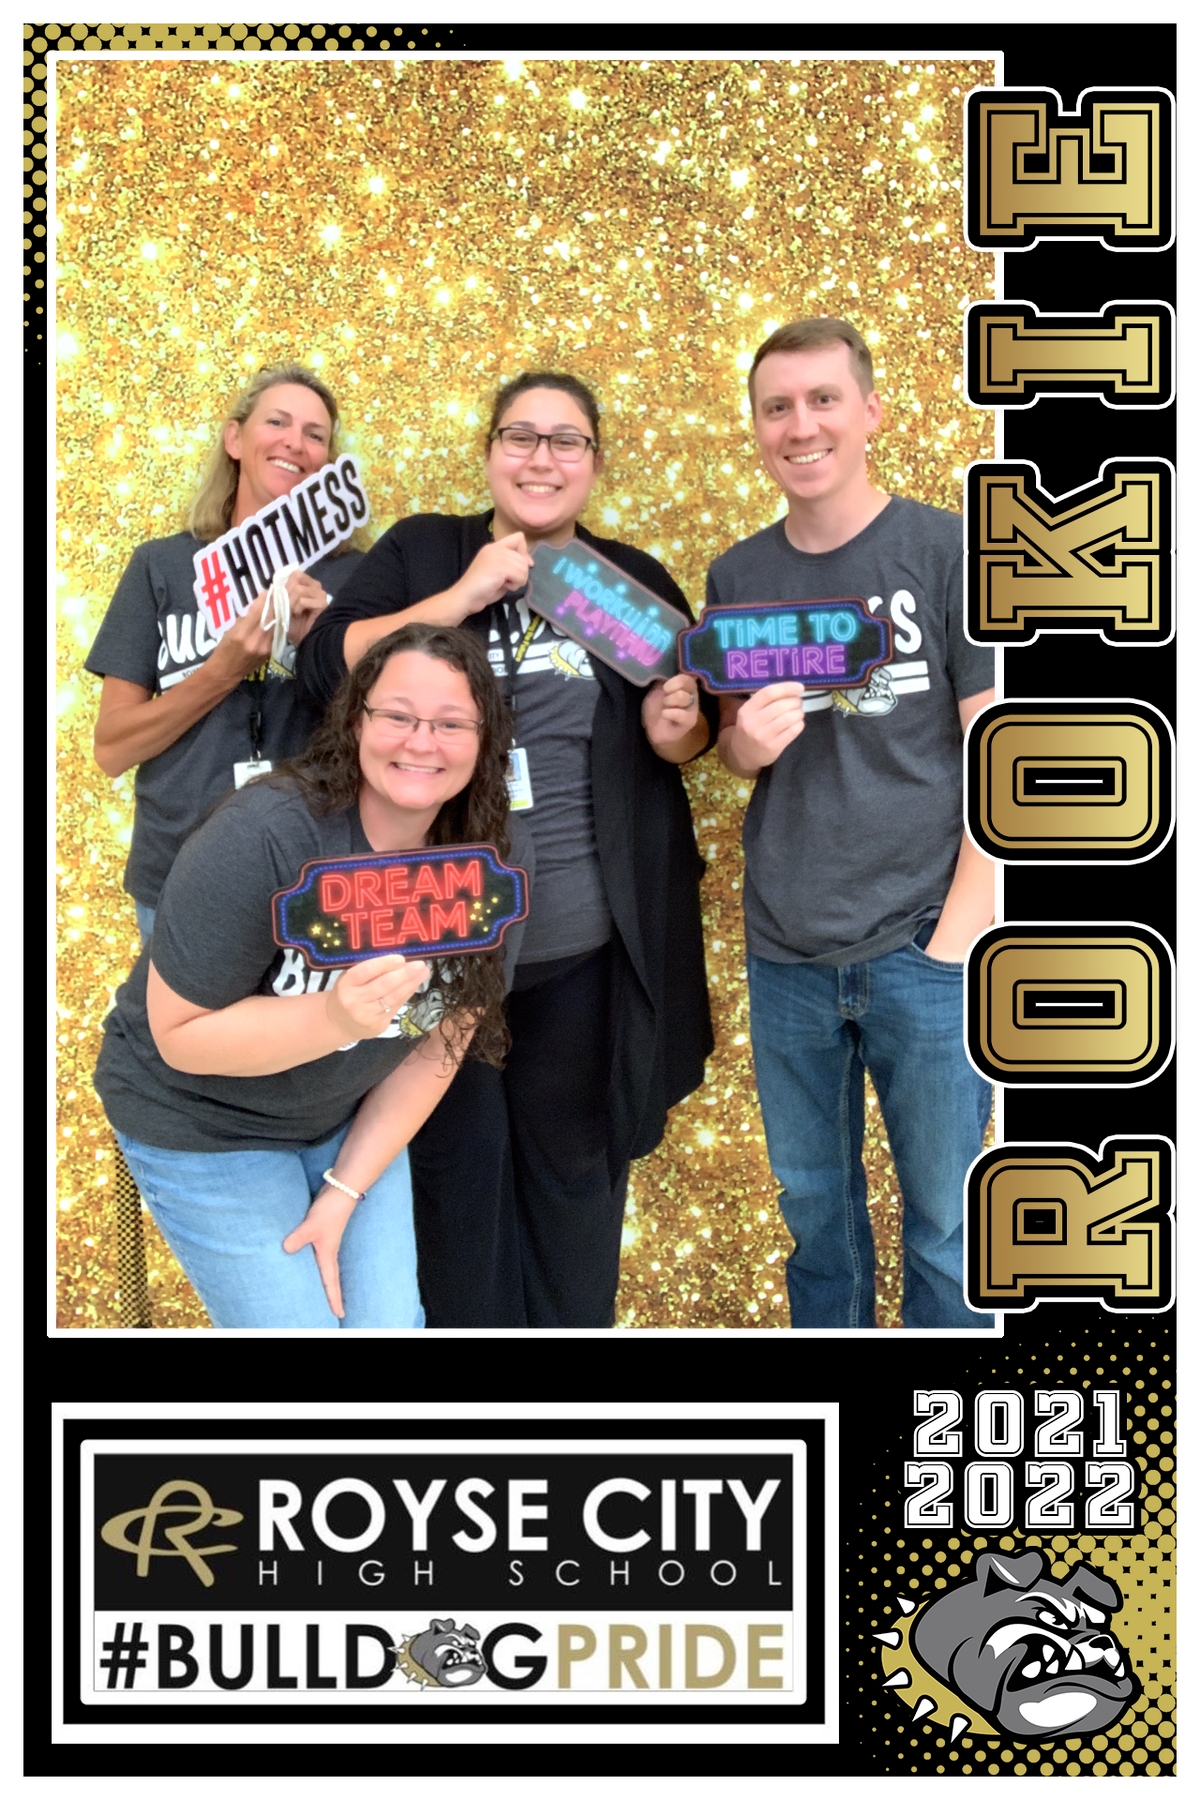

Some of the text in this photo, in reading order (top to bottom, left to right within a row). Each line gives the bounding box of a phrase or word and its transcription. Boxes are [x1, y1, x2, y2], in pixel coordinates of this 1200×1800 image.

[201, 459, 368, 629] #HOTMESS
[552, 557, 567, 575] I
[564, 563, 630, 620] WORK
[563, 589, 618, 635] PLAY
[713, 615, 798, 649] TIME
[808, 611, 857, 644] TO
[726, 645, 846, 679] RETIRE
[321, 860, 482, 913] DREAM
[340, 901, 468, 950] TEAM
